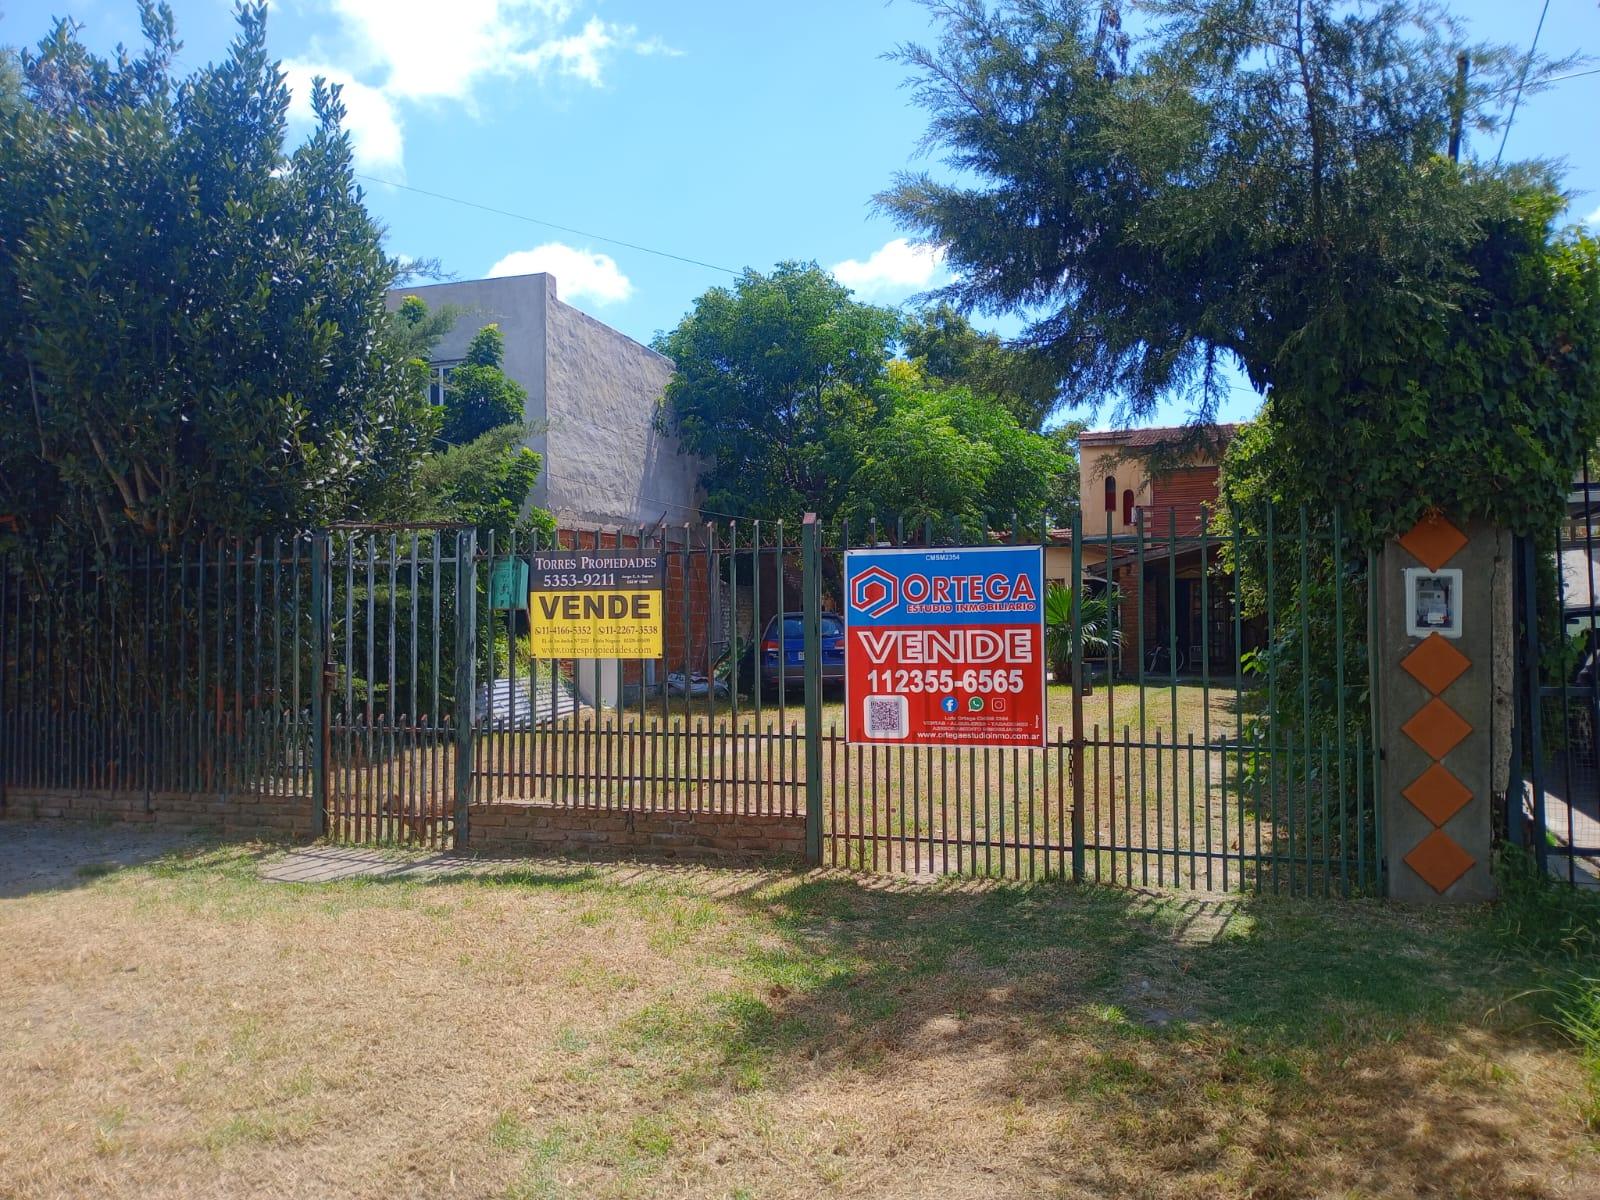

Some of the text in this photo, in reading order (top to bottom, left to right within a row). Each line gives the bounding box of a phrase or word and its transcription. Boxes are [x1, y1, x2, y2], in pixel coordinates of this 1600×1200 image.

[535, 556, 657, 570] TORRES PROPIEDADES
[543, 573, 616, 587] 5353-9211
[902, 573, 1036, 604] ORTEGA
[538, 594, 651, 620] VENDE
[906, 602, 1036, 613] ESTUDIO INMOBILIARIO
[541, 645, 652, 656] www.torrespropiedades.com
[857, 629, 1033, 664] VENDE
[867, 669, 1024, 693] 112355-6565
